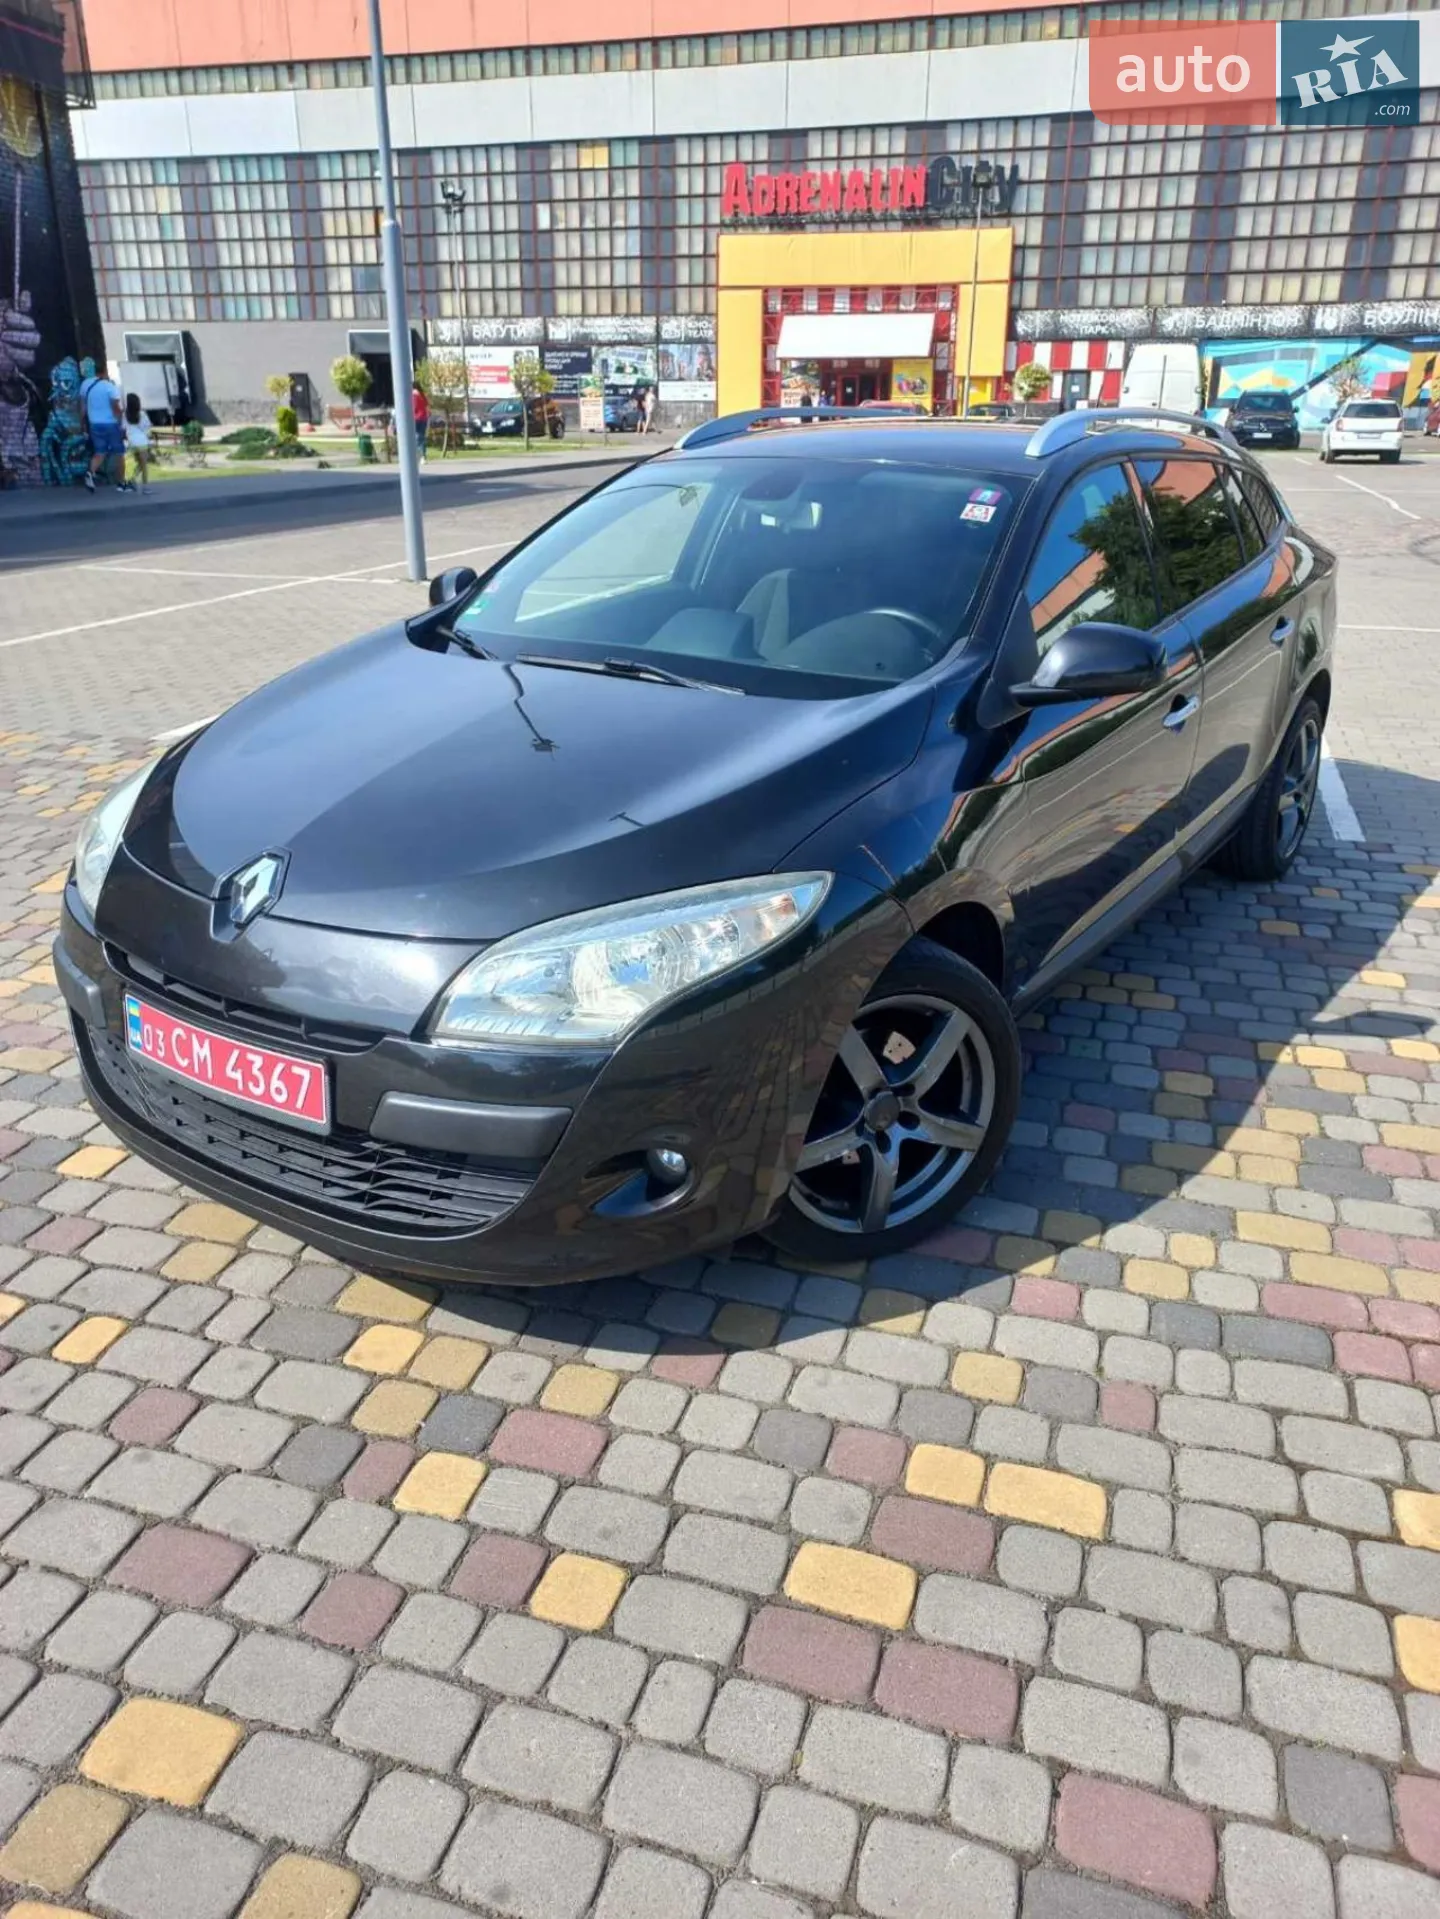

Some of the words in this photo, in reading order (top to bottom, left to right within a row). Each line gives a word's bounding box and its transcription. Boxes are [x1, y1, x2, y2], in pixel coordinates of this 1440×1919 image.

[471, 324, 526, 339] БАТУТИ
[143, 1023, 165, 1059] 03
[225, 1048, 311, 1110] 4367
